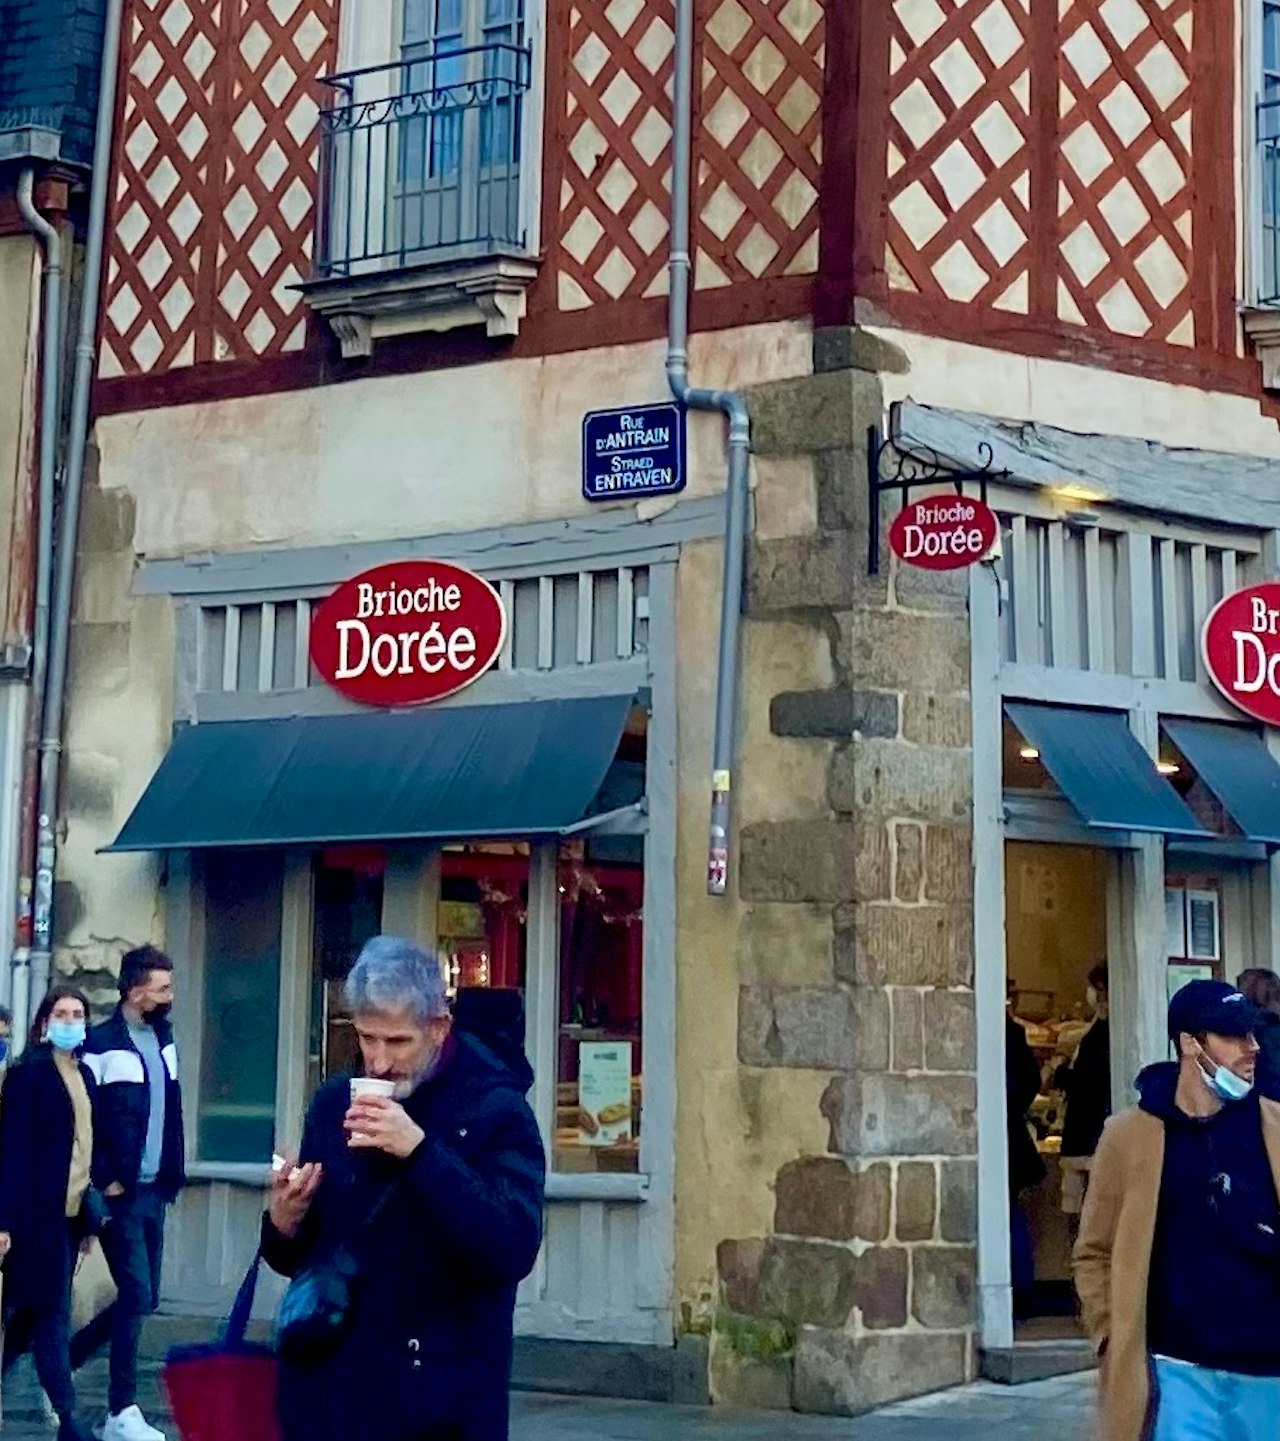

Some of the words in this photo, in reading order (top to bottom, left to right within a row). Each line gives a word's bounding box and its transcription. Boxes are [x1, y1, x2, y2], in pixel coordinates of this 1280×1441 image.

[595, 467, 672, 491] ENTRAVEN
[915, 502, 975, 525] Brioche
[903, 525, 983, 558] Dorée
[357, 577, 461, 618] Brioche
[335, 619, 476, 680] Dorée
